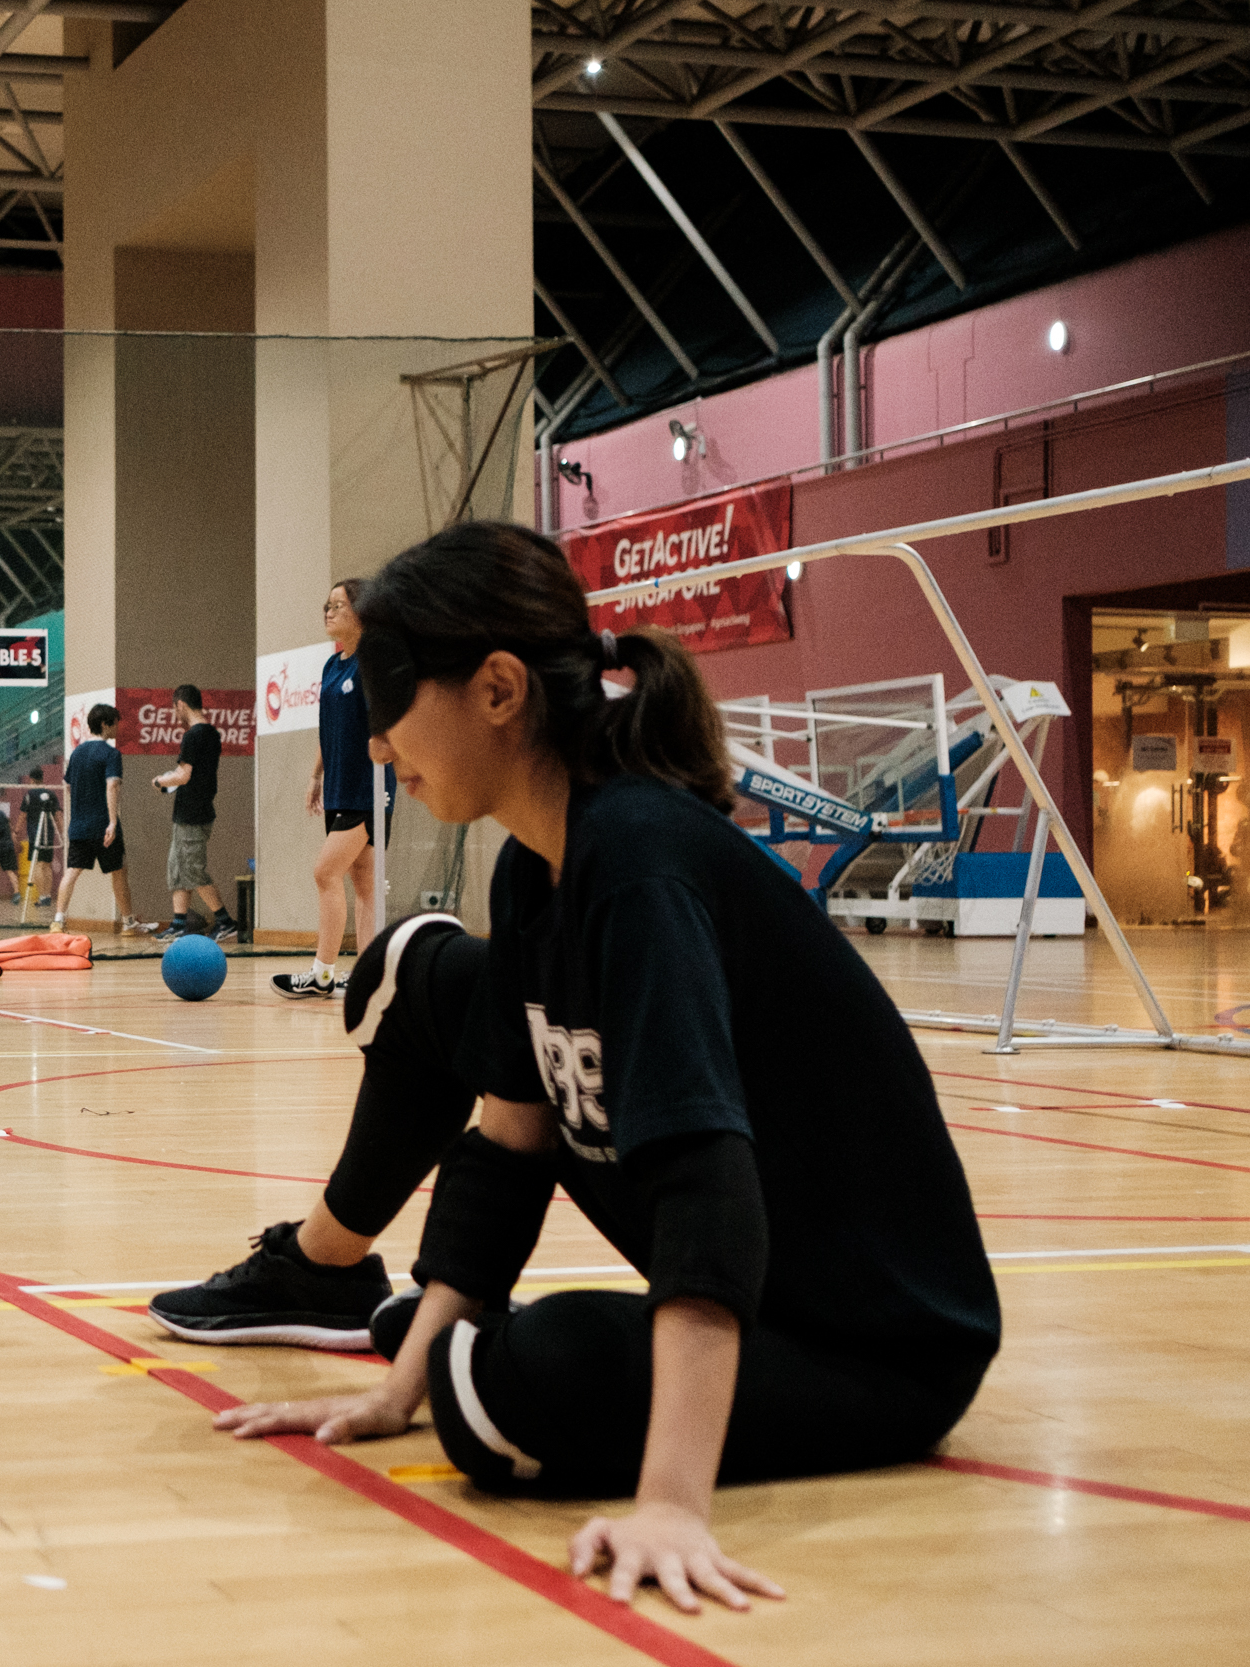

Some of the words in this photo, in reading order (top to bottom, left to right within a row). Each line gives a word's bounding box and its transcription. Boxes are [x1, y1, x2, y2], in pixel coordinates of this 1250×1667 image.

[30, 648, 42, 666] 5
[138, 726, 251, 745] SINGORE
[750, 774, 869, 829] SPORTSYSTEM
